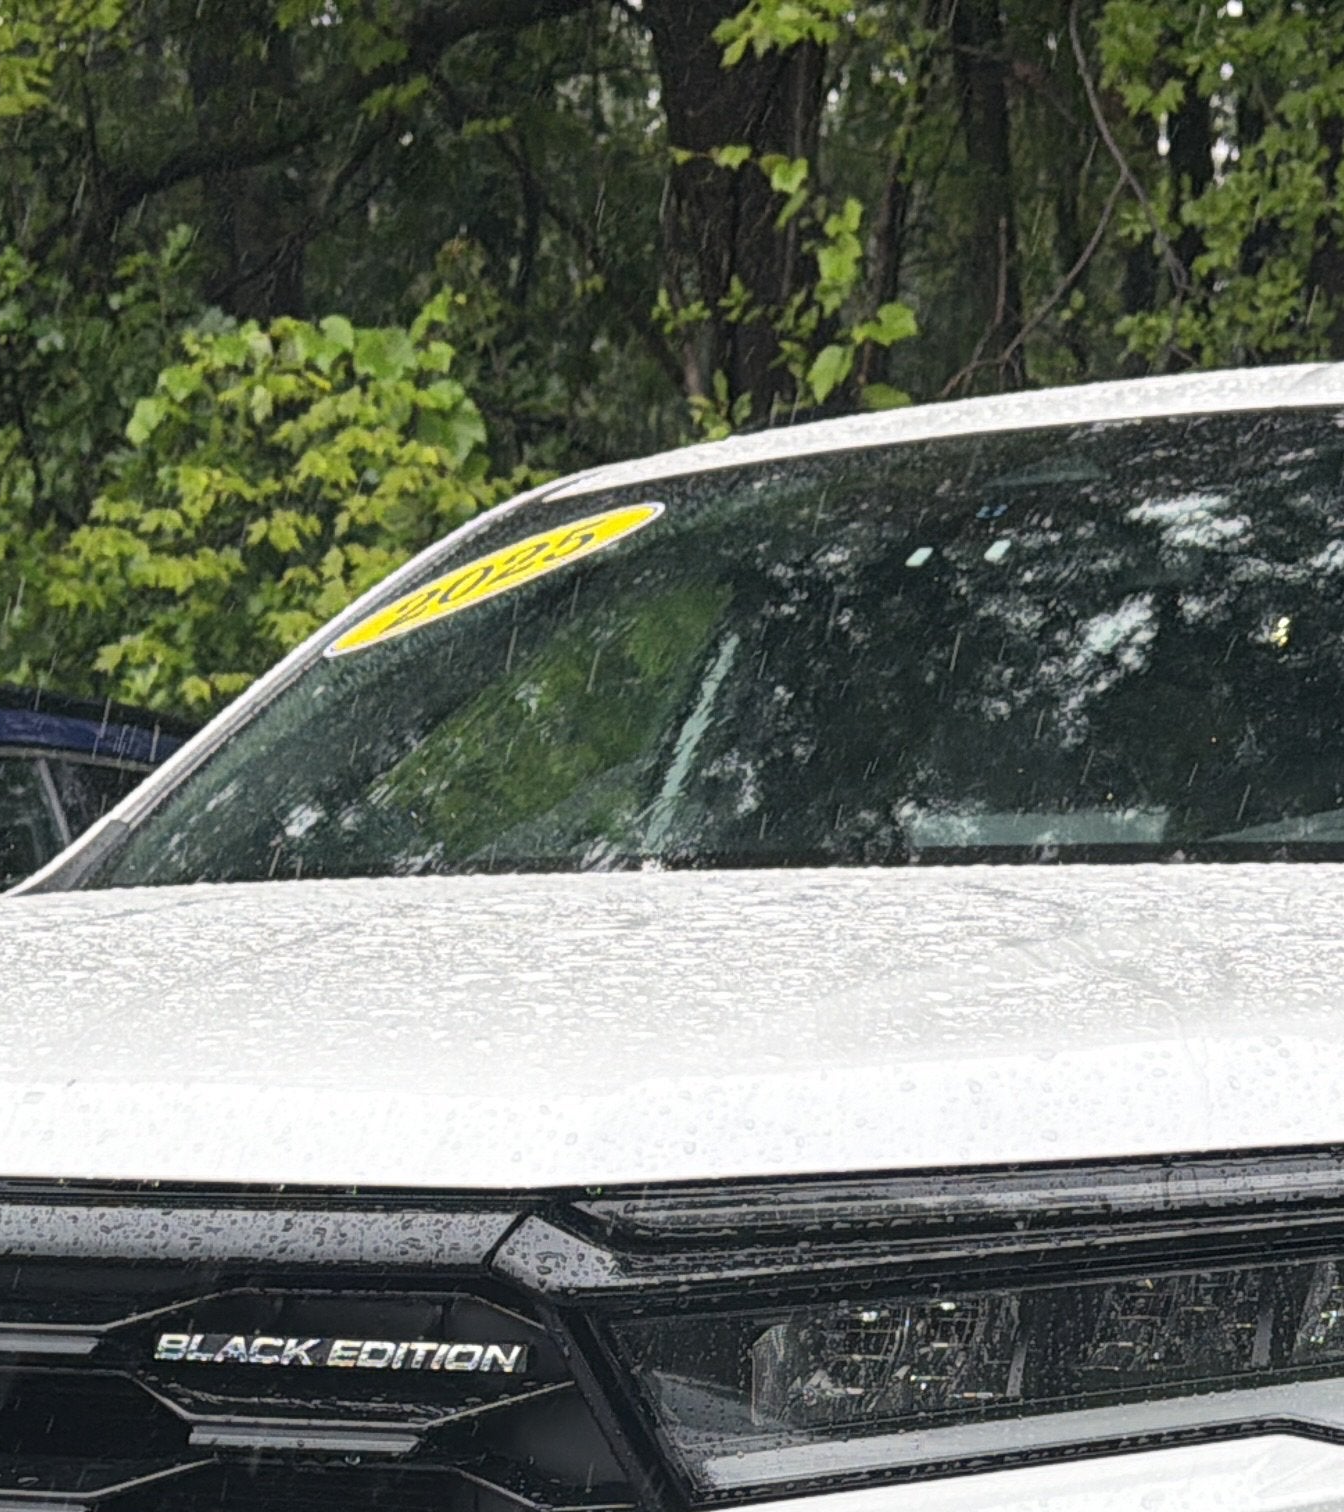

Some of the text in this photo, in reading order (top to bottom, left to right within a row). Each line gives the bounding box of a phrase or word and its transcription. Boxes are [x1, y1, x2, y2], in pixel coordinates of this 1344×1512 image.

[379, 518, 606, 635] 2025
[154, 1333, 522, 1373] BLACK EDITION
